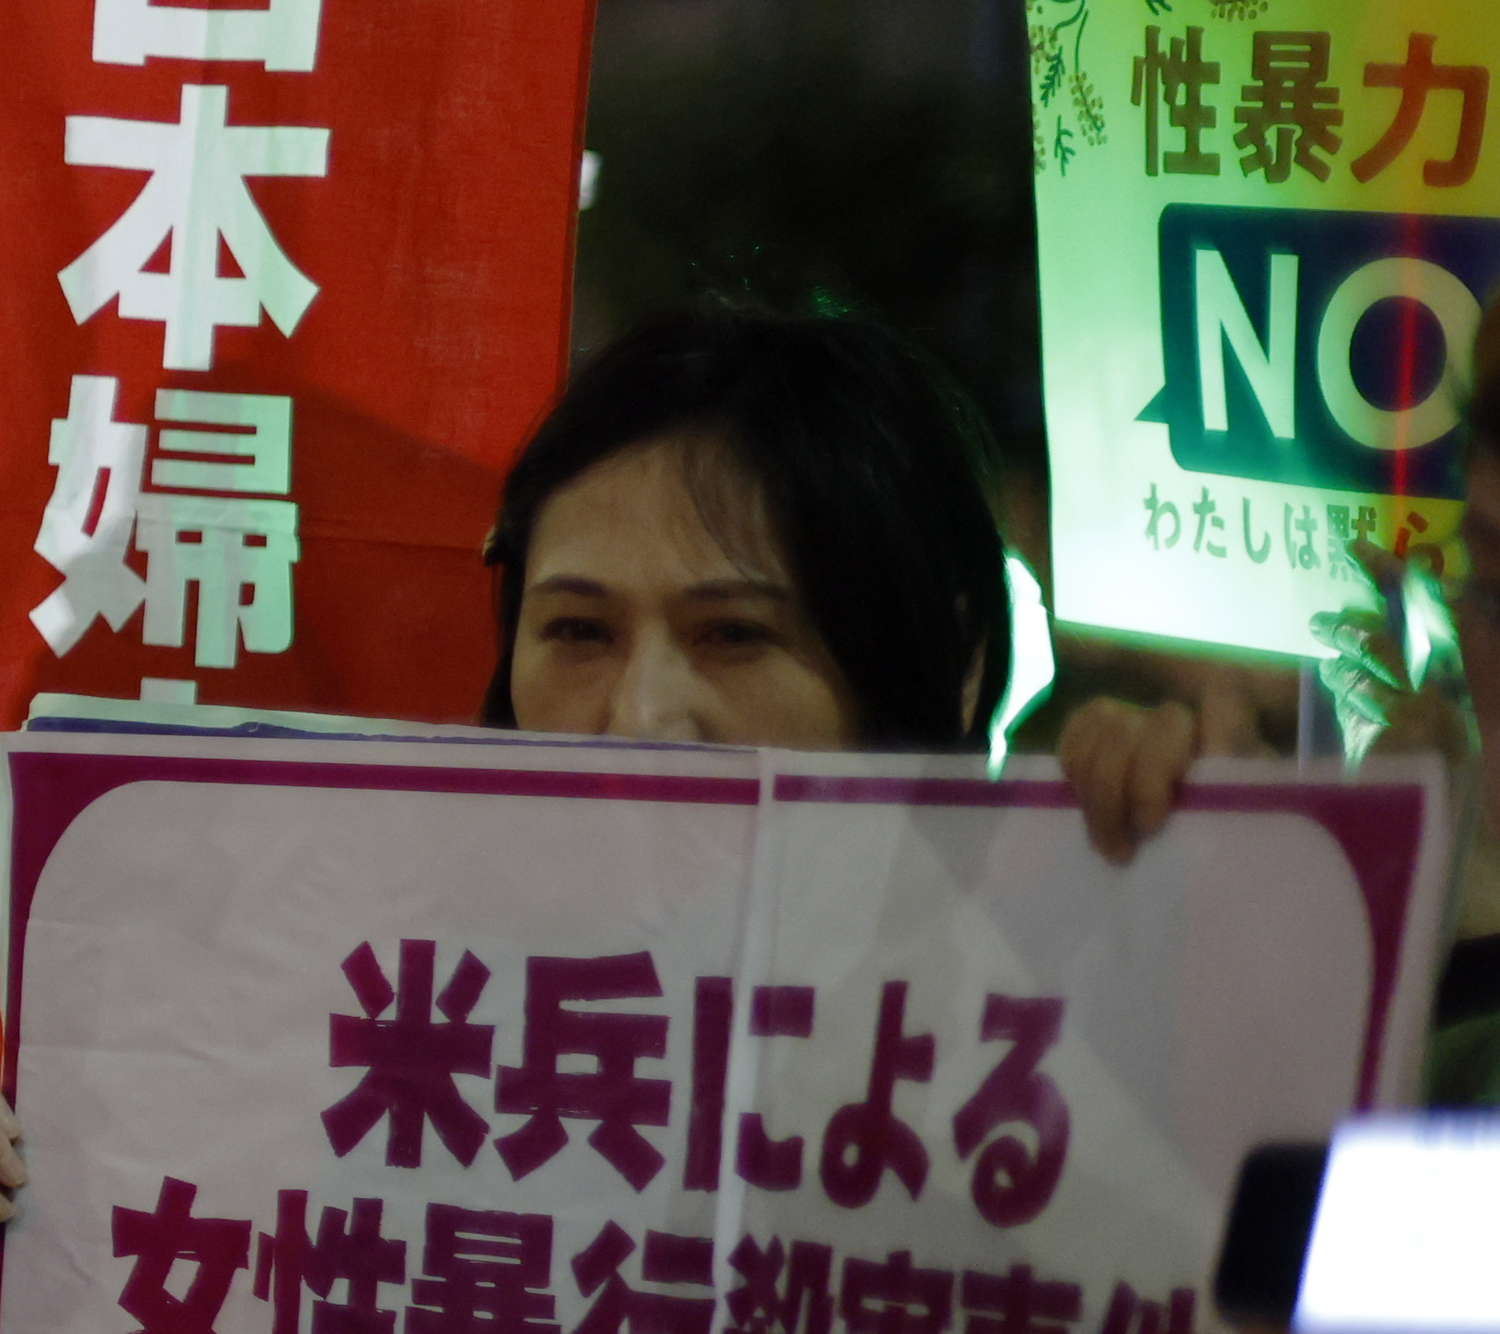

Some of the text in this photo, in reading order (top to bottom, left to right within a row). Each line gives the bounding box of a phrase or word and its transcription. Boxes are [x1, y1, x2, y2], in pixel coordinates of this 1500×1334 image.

[1130, 23, 1492, 189] 性暴力
[1193, 247, 1485, 453] NO
[320, 937, 1072, 1229] 米兵による
